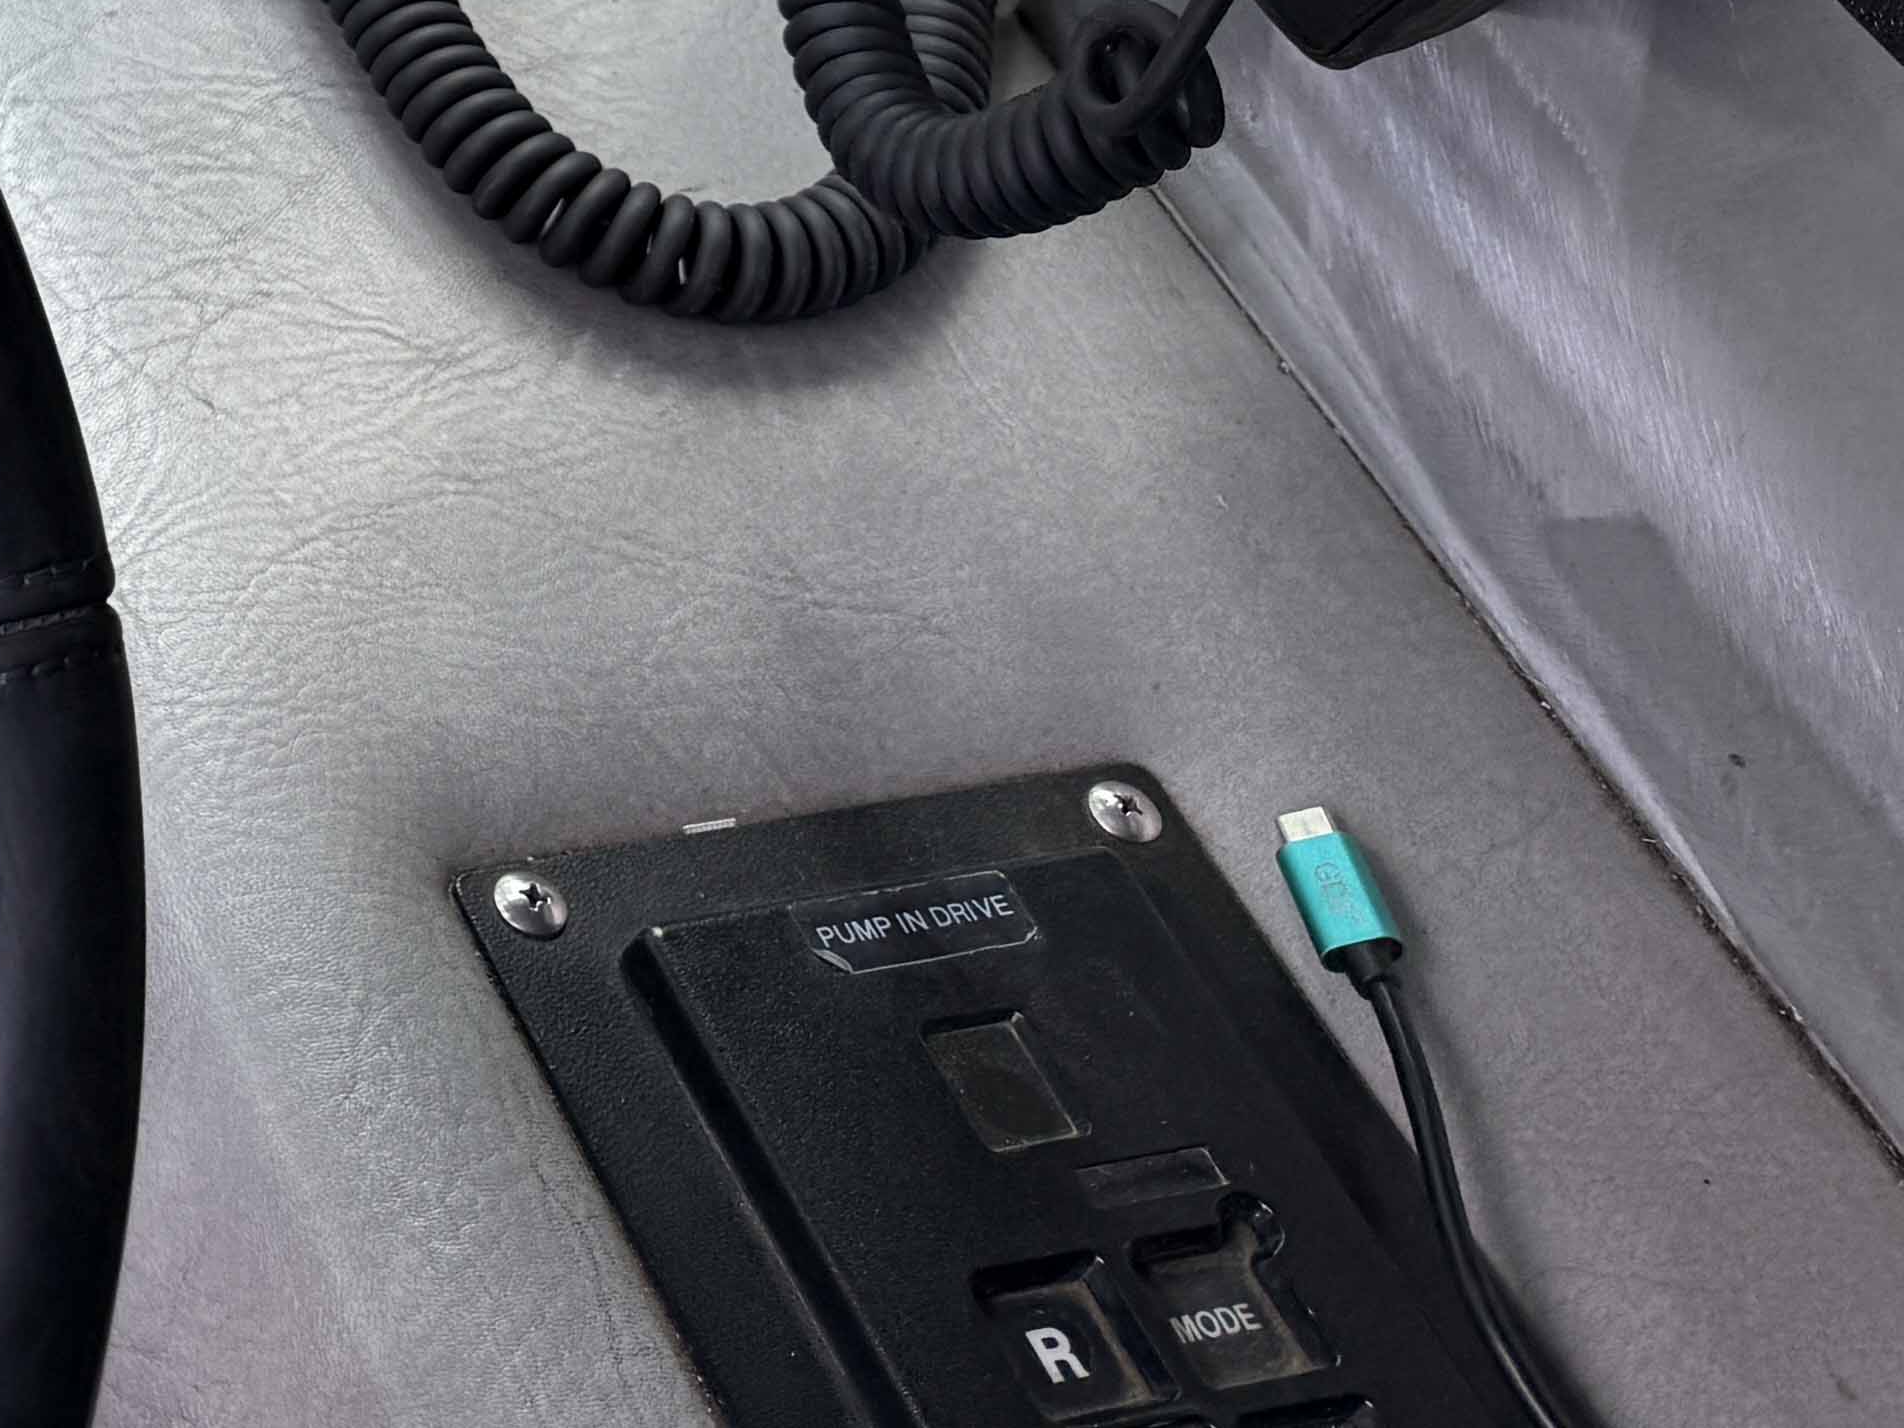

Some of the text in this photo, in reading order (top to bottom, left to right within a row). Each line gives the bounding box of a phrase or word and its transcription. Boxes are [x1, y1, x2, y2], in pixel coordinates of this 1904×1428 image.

[815, 894, 1015, 948] PUMP IN DRIVE
[1168, 1302, 1264, 1345] MODE
[1024, 1326, 1091, 1385] R
